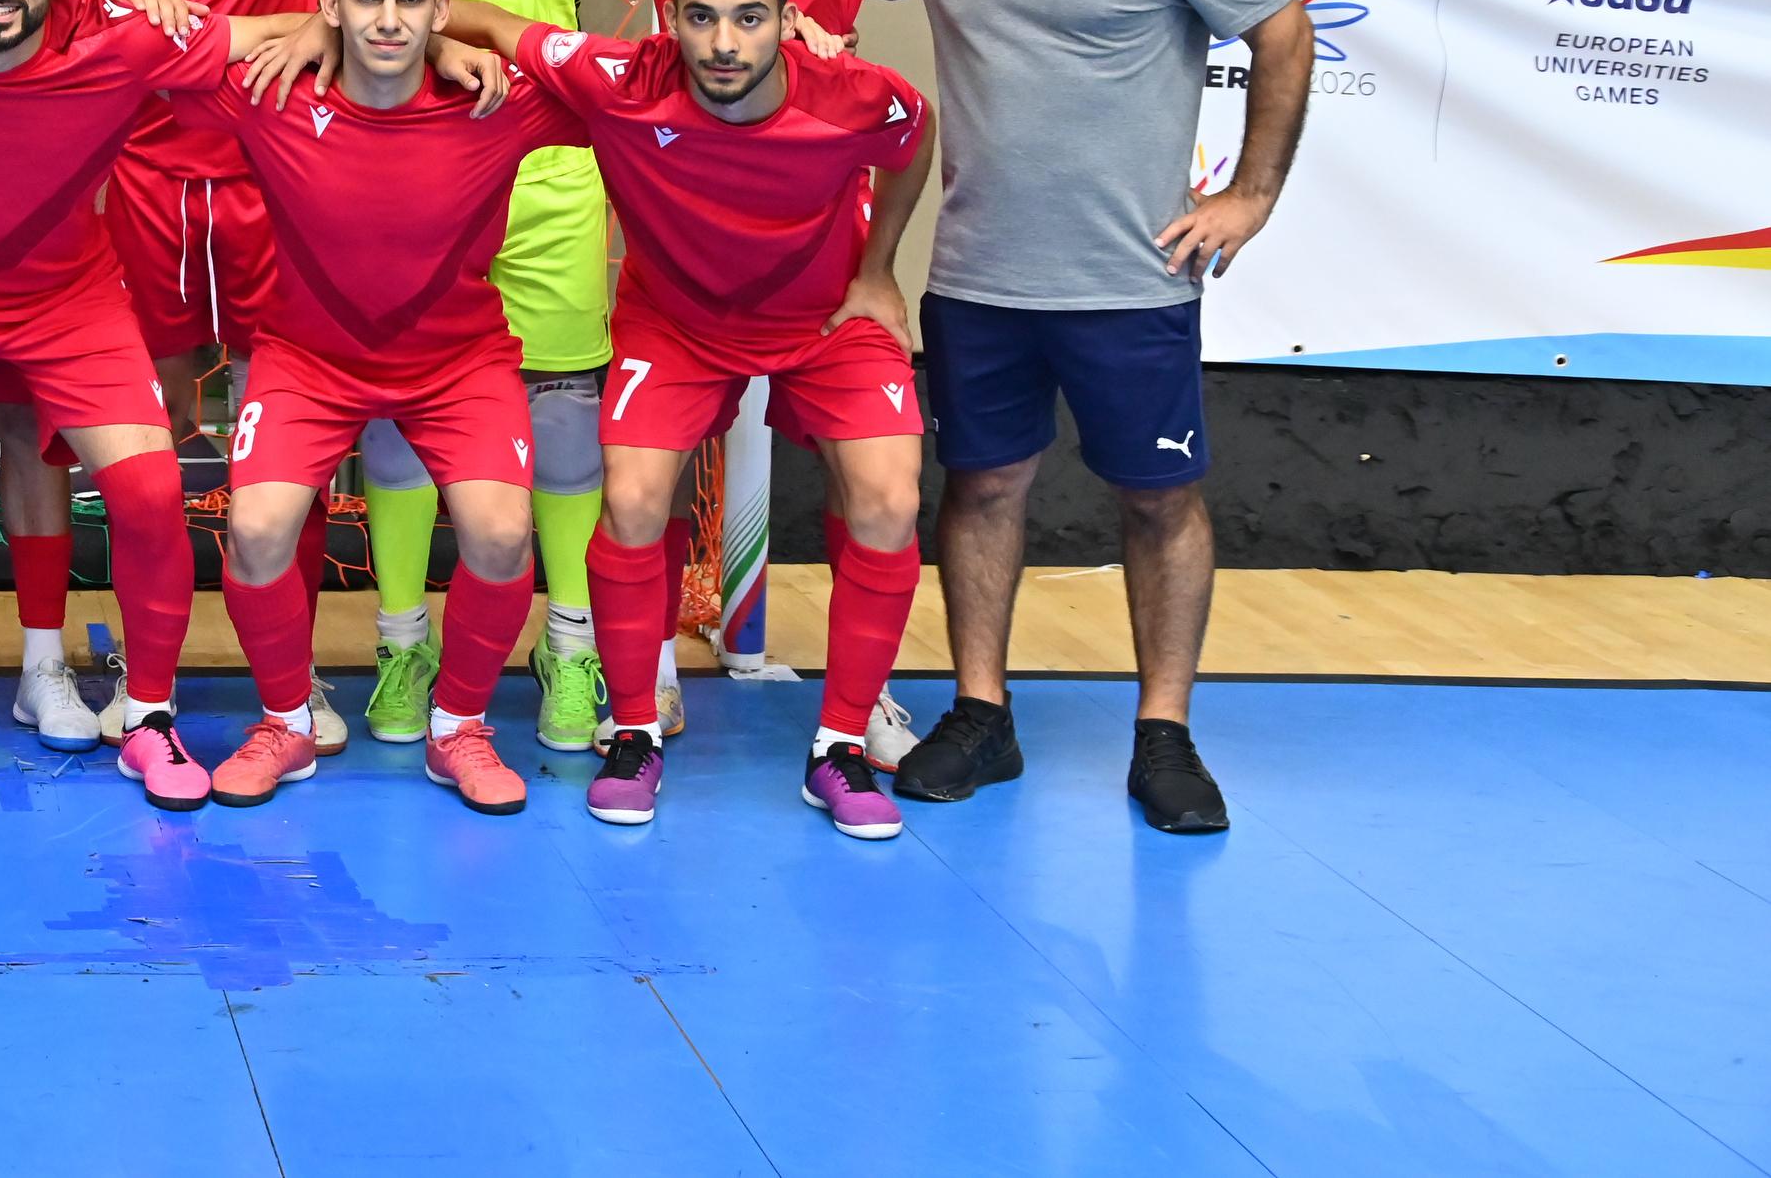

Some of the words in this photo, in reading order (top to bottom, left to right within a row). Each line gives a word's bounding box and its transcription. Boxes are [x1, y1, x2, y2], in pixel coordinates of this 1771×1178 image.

[1556, 33, 1694, 57] EUROPEAN
[1535, 55, 1710, 83] UNIVERSITIES
[1575, 85, 1660, 106] GAMES
[611, 357, 653, 421] 7
[232, 401, 264, 462] 8
